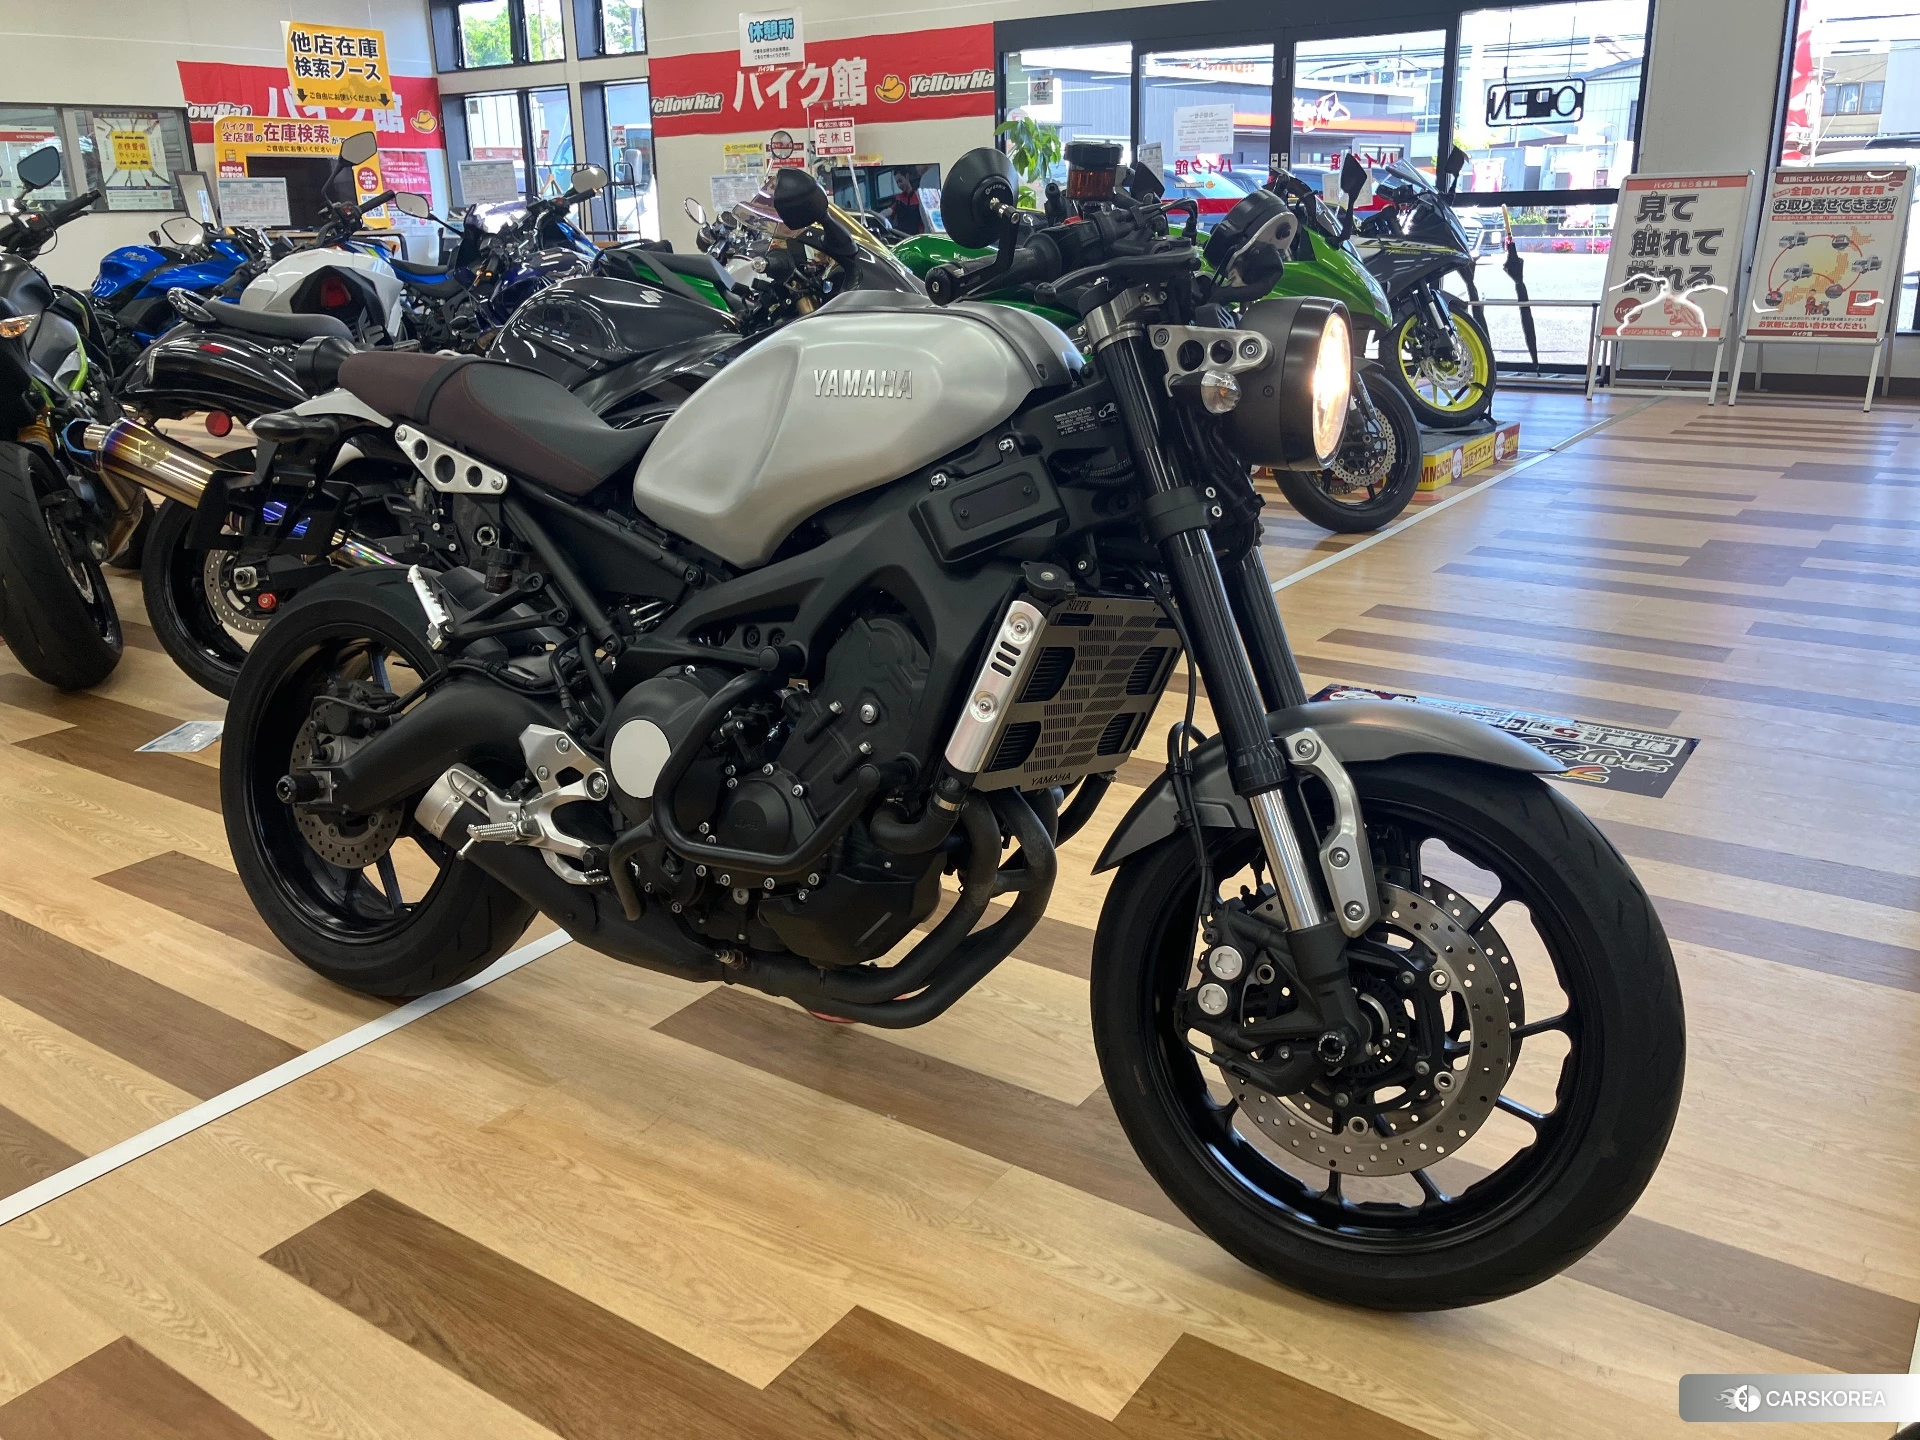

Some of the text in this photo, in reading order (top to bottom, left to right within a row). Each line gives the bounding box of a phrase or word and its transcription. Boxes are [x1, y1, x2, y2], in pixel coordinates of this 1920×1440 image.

[748, 18, 794, 43] 休憩所
[290, 30, 379, 59] 他店在庫
[294, 56, 381, 82] 検索ブース
[733, 57, 868, 114] バイク館
[910, 71, 995, 94] YellowHa
[309, 92, 377, 102] ご自由にお使いください
[819, 132, 851, 144] 定休日
[1634, 194, 1700, 224] 見て
[1773, 197, 1898, 214] お取り寄せできます!
[1629, 228, 1724, 258] 触れて
[813, 368, 913, 400] YAMAHA
[1031, 772, 1072, 786] YAMAHA
